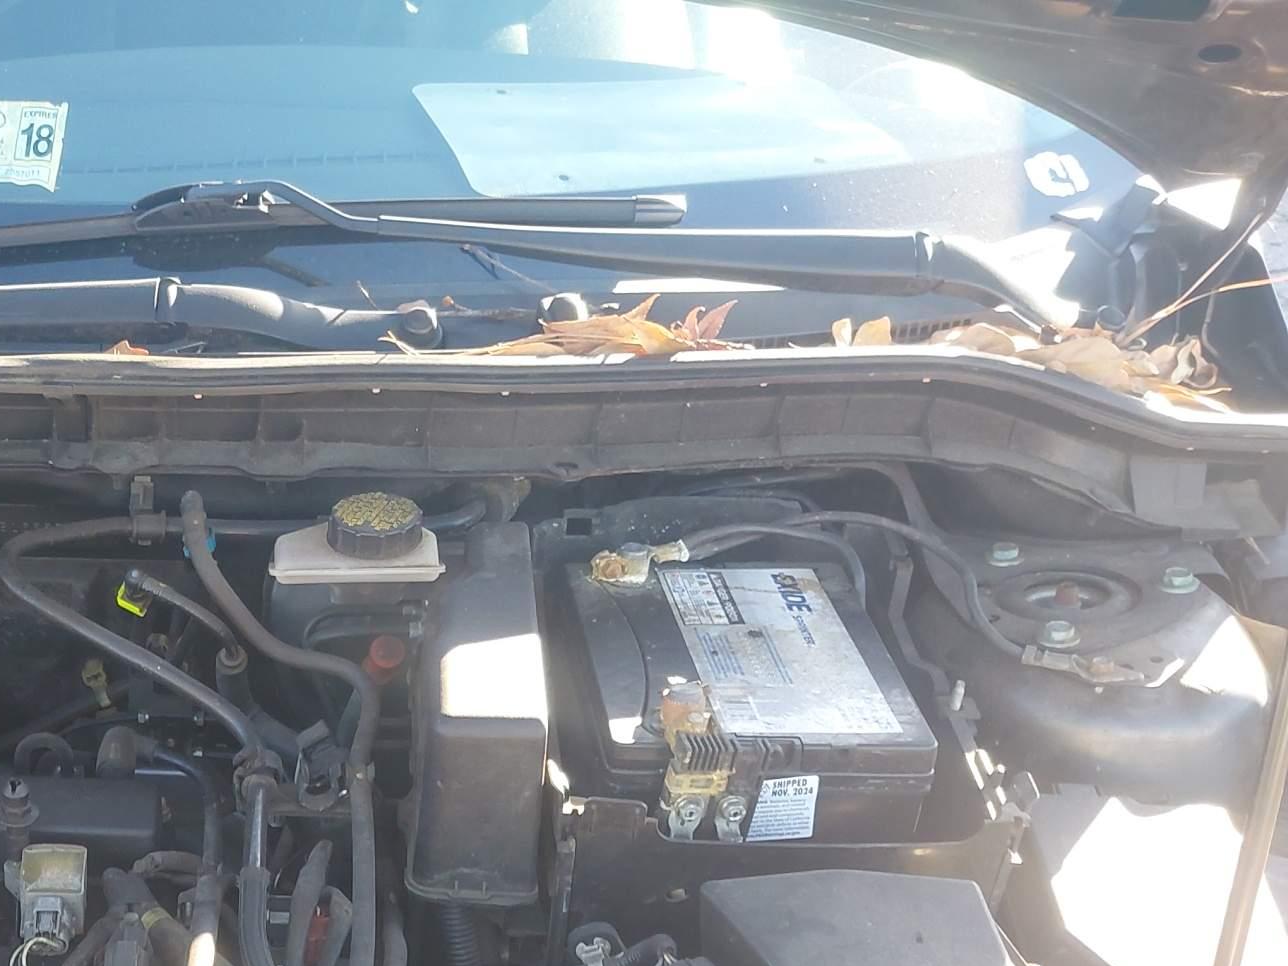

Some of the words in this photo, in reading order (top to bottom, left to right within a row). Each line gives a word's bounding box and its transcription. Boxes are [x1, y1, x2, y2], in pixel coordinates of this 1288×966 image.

[24, 110, 57, 119] EXPIRES
[21, 123, 54, 157] 18
[771, 573, 812, 612] EXIDE
[772, 778, 808, 788] SHIPPED
[772, 789, 790, 797] NOV.
